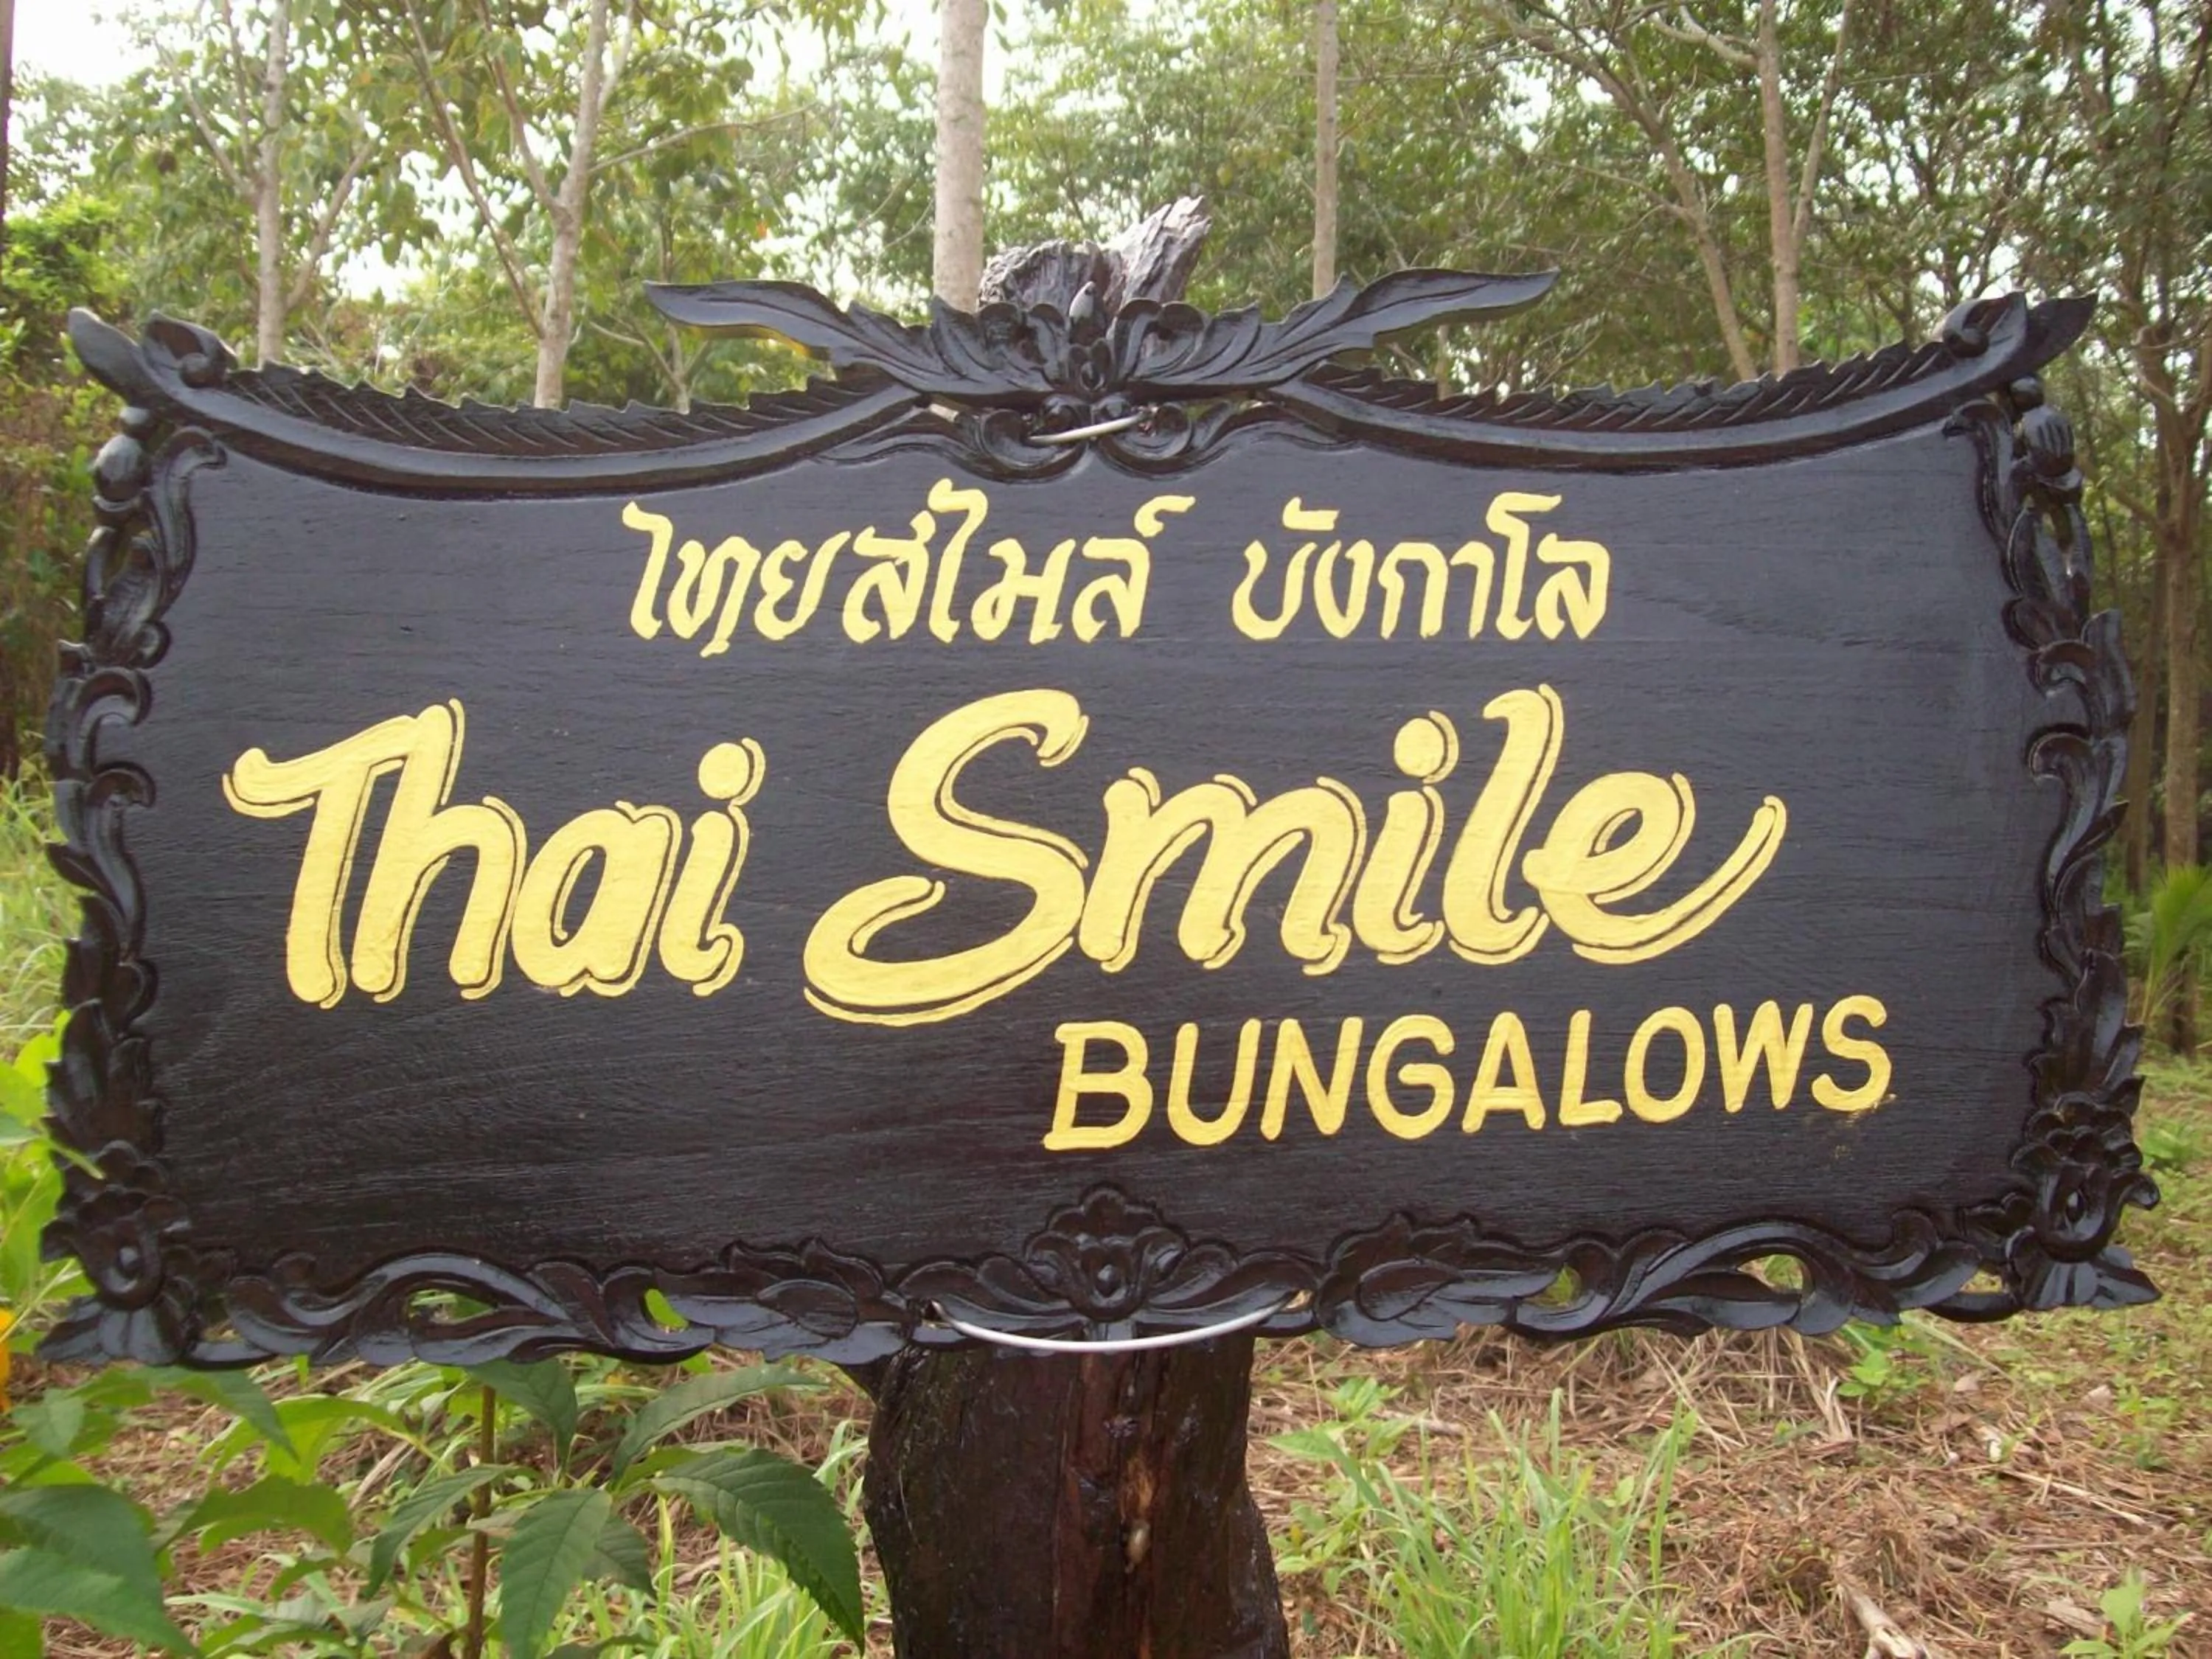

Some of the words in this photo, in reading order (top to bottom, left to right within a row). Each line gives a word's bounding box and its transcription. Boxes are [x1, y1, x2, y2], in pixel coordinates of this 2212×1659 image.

[1232, 492, 1610, 642] บังกาโล
[223, 698, 765, 1010] Thai
[803, 684, 1789, 1026] Smile
[1043, 995, 1892, 1152] BUNGALOWS
